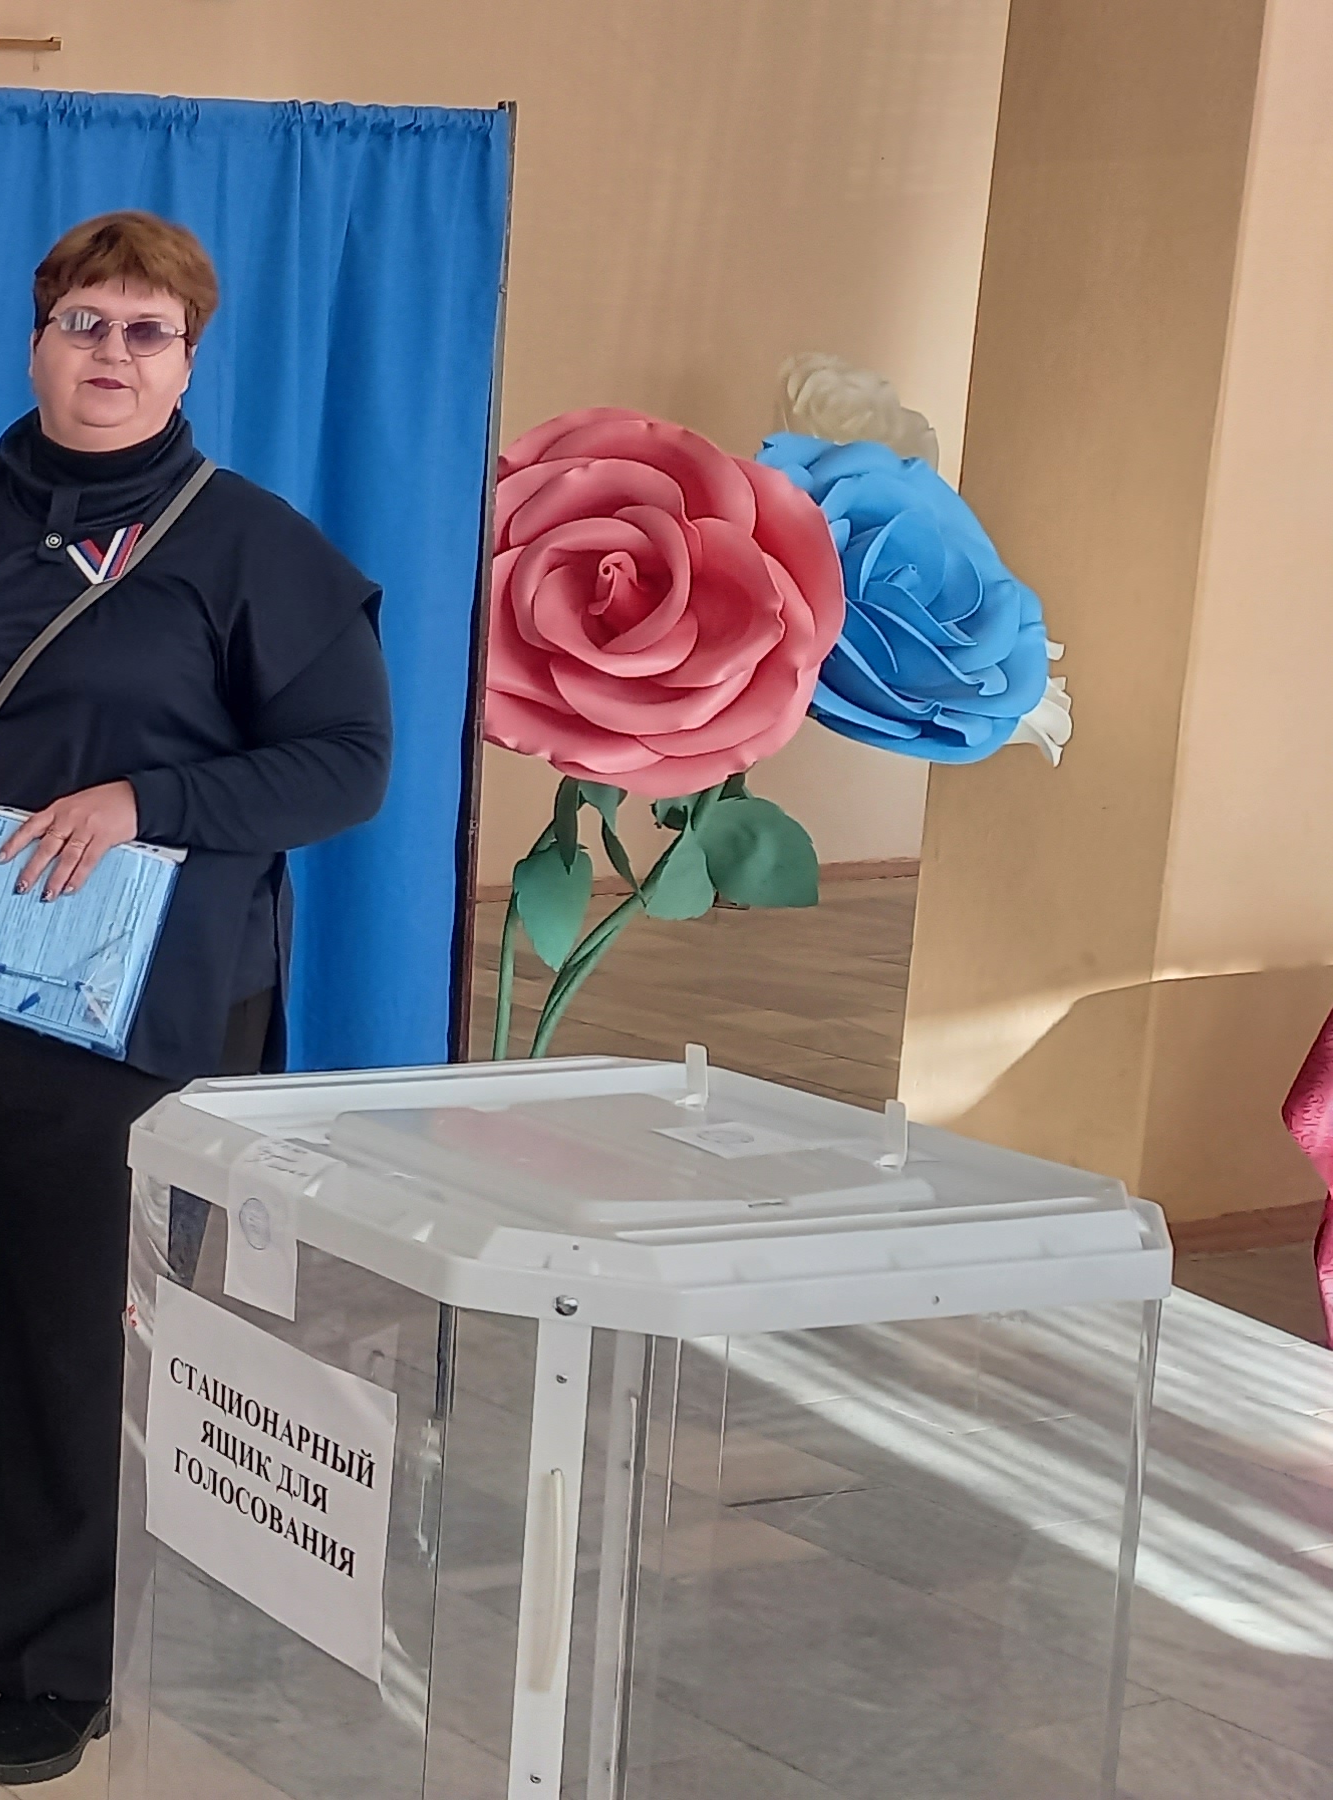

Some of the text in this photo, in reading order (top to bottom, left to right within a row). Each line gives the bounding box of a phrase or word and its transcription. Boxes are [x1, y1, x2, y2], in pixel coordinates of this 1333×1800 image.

[169, 1356, 376, 1490] СТАЦИОНАРНЫЙ
[200, 1420, 330, 1515] ЯЩИК ДЛЯ
[174, 1447, 357, 1580] ГОЛОСОВАНИЯ
